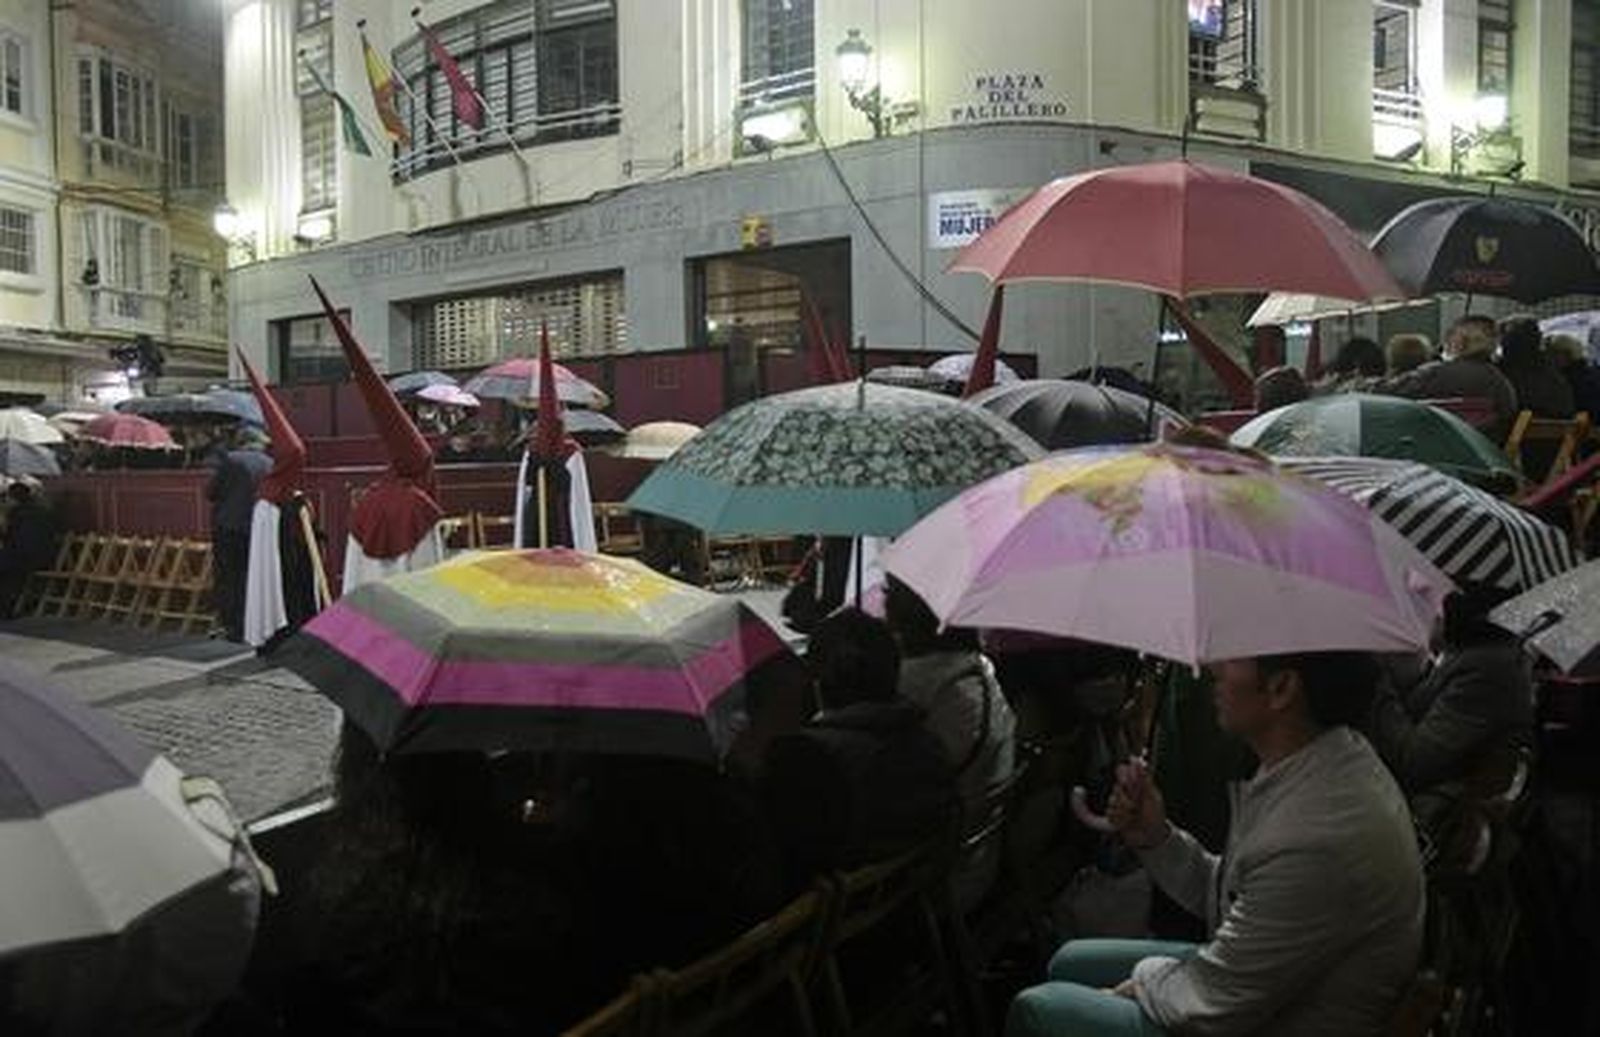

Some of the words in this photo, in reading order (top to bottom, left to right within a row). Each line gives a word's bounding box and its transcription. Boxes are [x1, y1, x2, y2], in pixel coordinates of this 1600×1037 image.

[976, 74, 1044, 89] PLAZA
[988, 90, 1028, 103] DEL
[952, 101, 1067, 119] PALILLERO
